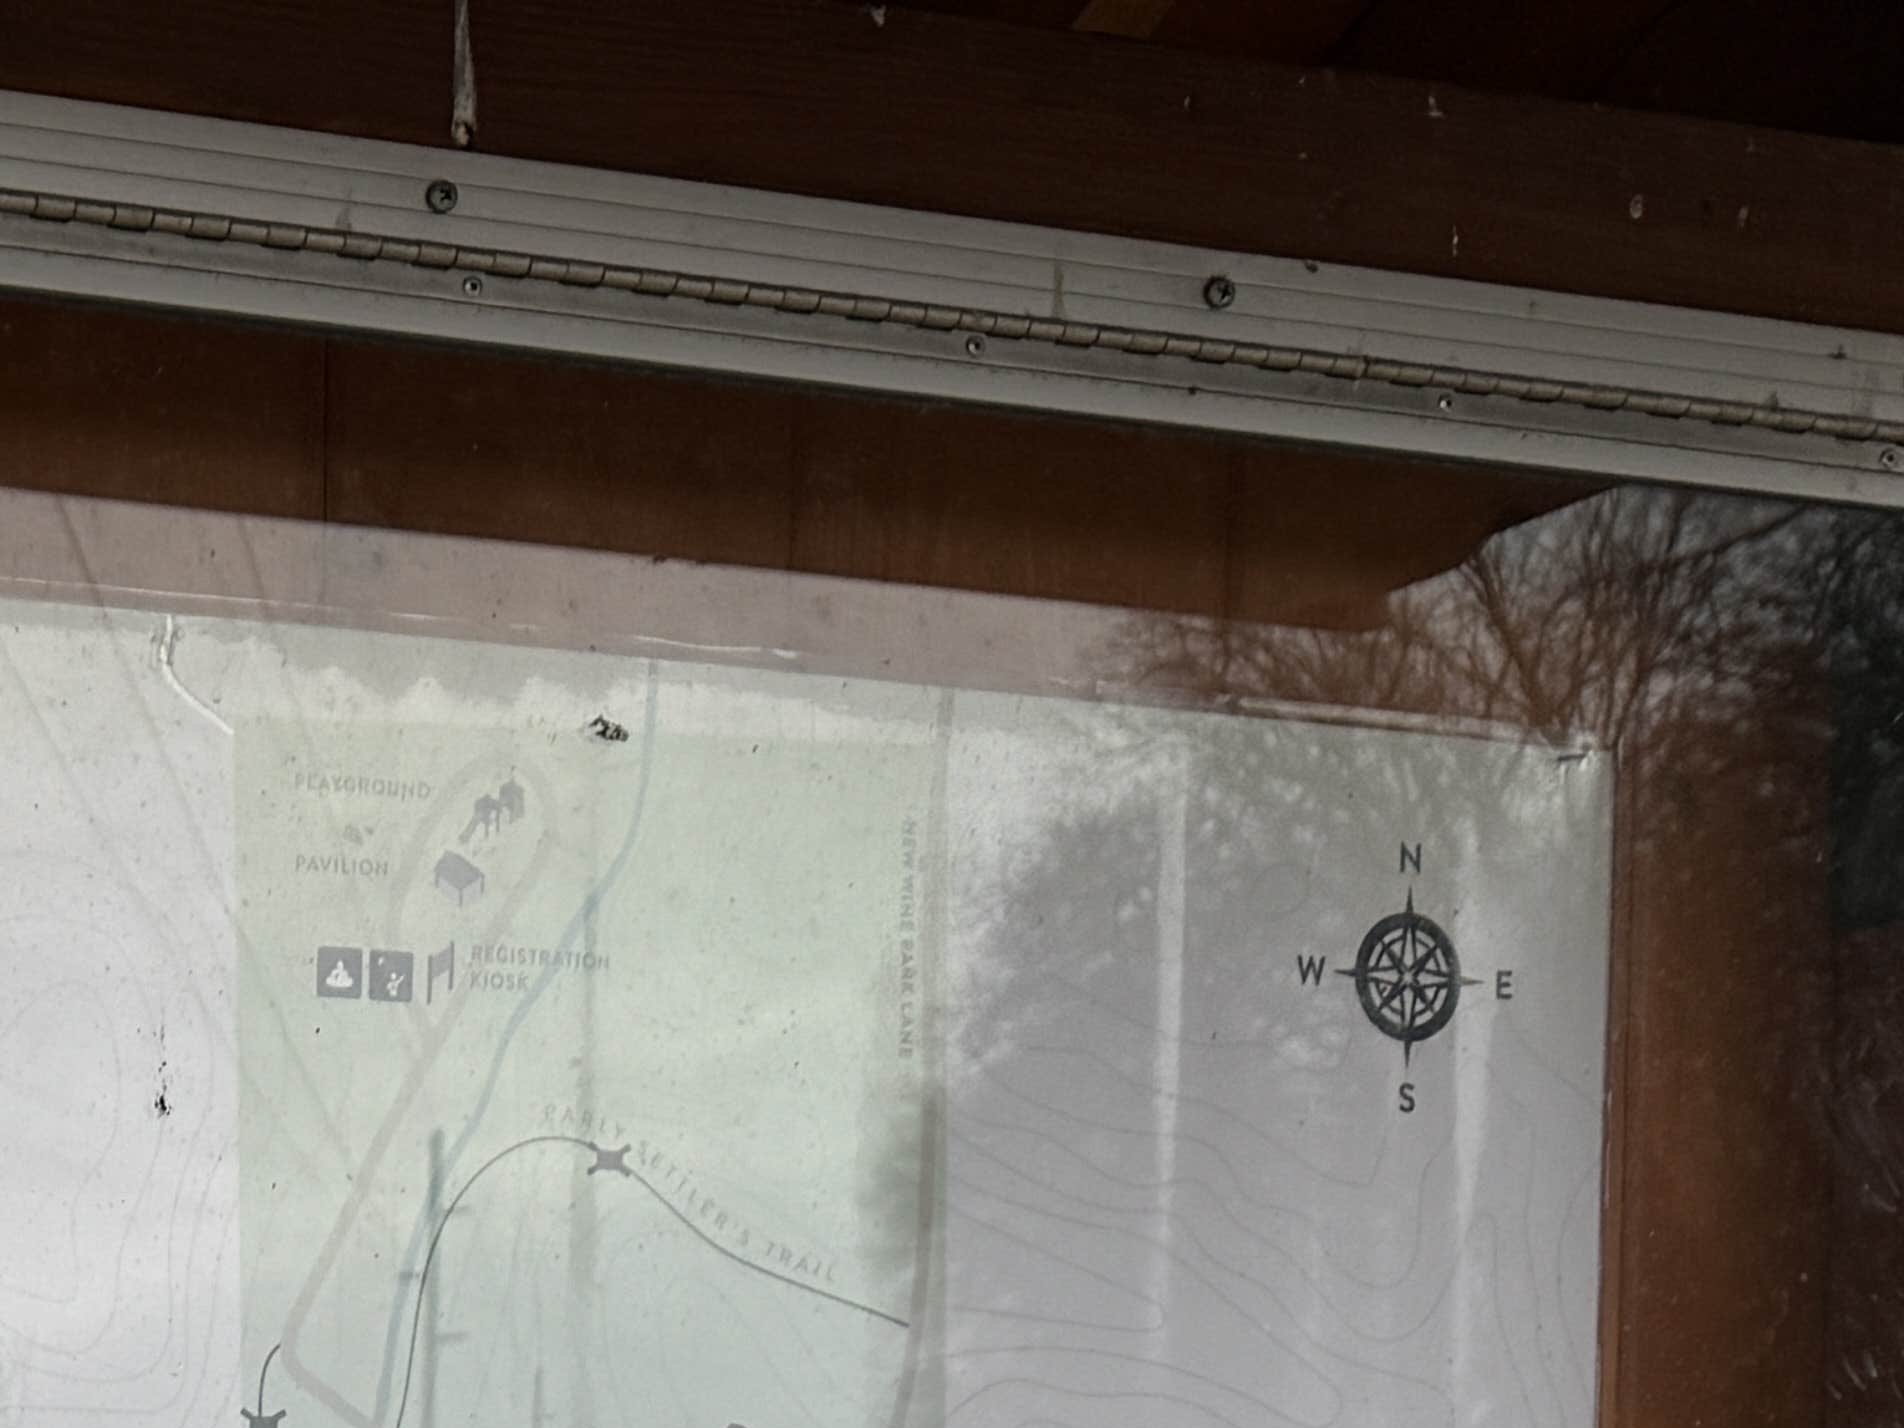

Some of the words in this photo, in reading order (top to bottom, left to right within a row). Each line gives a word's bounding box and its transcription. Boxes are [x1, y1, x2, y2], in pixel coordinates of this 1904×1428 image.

[294, 773, 431, 800] PLAYGROUND
[295, 855, 389, 877] PAVILION
[1400, 842, 1422, 874] N
[471, 945, 610, 971] REGISTRATION
[1297, 955, 1325, 986] W
[470, 971, 528, 993] KIOSK
[1496, 970, 1513, 999] E
[1399, 1083, 1415, 1113] S
